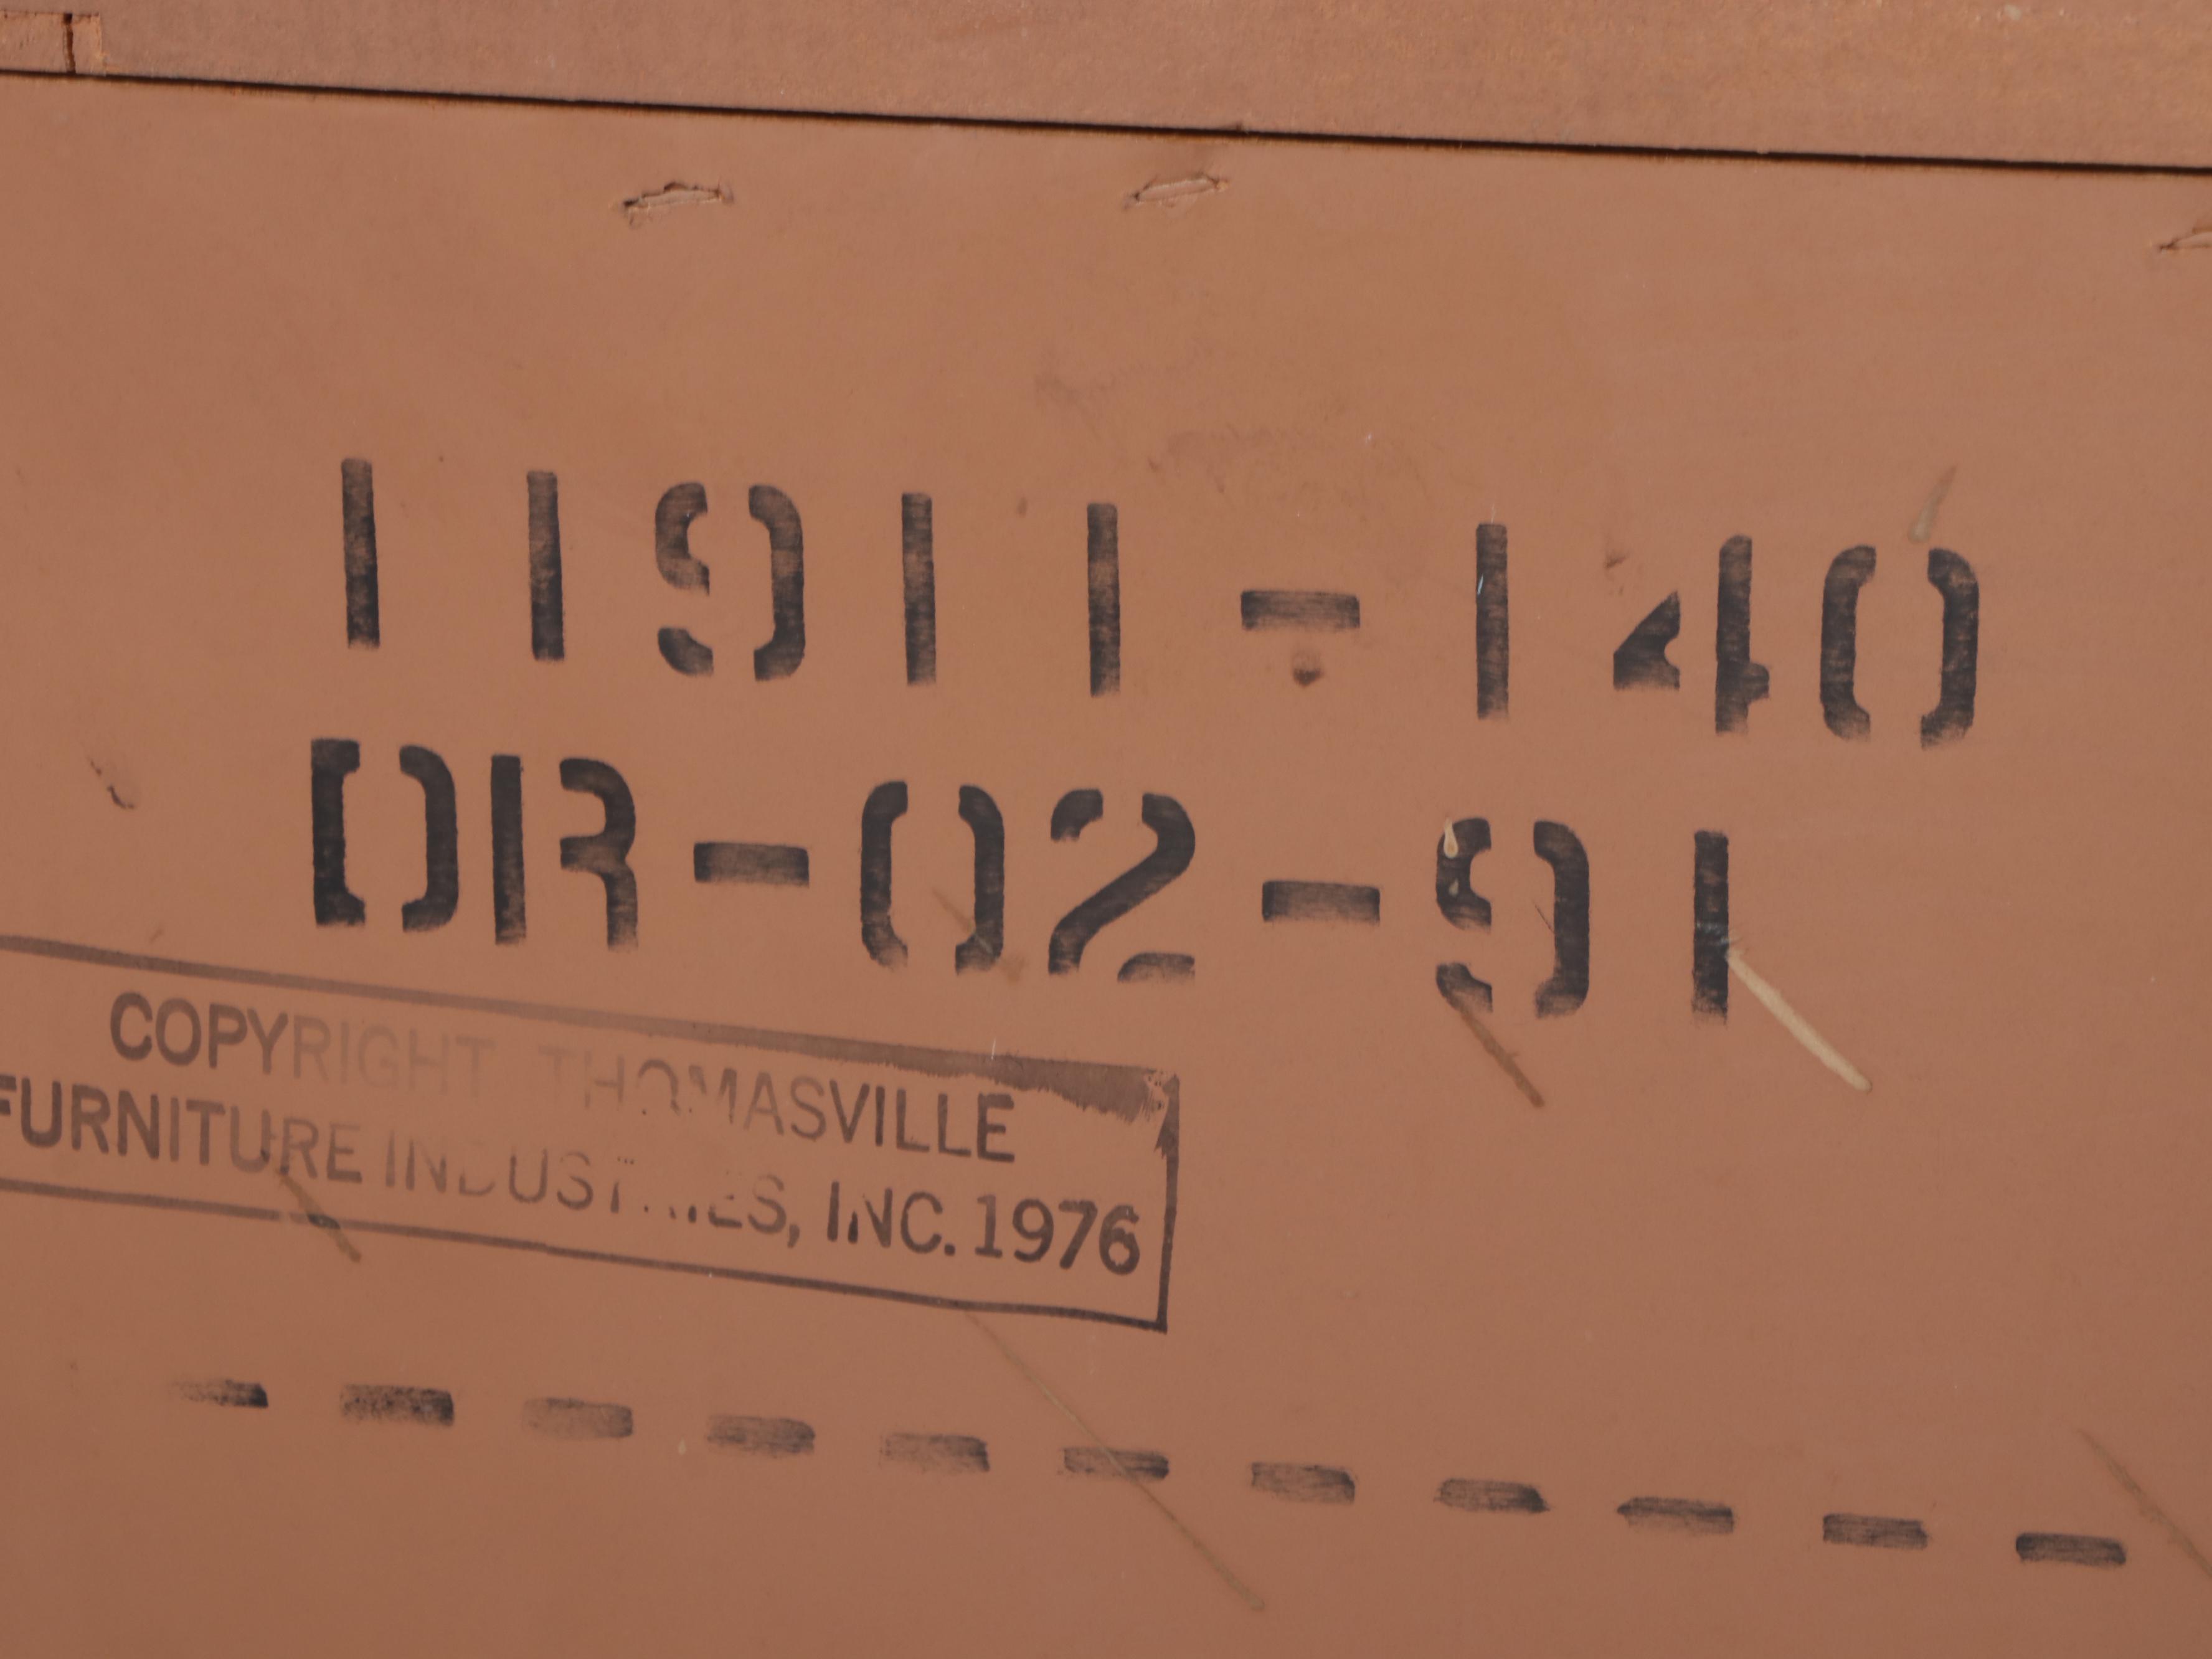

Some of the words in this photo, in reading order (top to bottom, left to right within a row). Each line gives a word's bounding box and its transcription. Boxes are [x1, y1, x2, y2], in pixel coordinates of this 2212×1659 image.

[341, 458, 1980, 750] 11911-140
[310, 738, 1730, 1026] DR-02-91
[110, 991, 497, 1098] COPYRIGHT
[539, 1045, 1015, 1163] THOMASVILLE
[384, 1130, 801, 1248] INUSS,
[826, 1181, 956, 1257] INC.
[973, 1193, 1141, 1275] 1976
